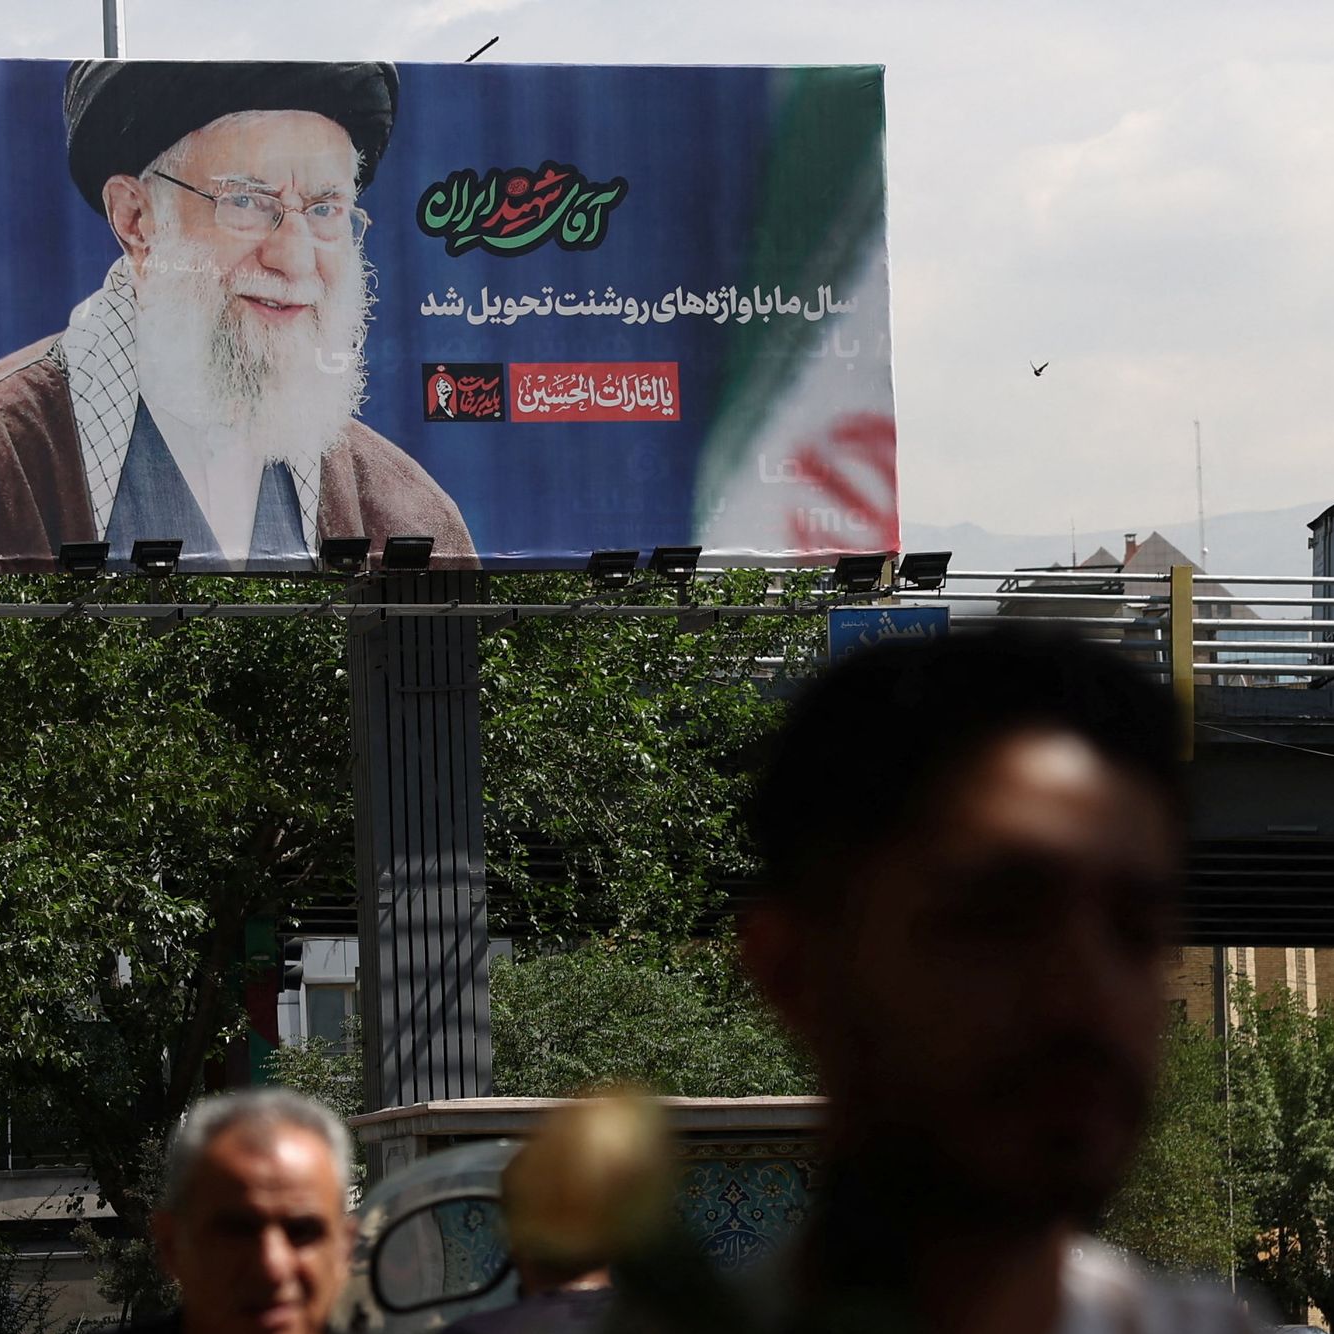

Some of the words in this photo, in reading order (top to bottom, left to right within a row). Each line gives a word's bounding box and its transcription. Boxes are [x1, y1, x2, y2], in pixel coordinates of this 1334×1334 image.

[425, 177, 497, 248] ایران
[420, 285, 465, 317] شد
[467, 285, 554, 326] تحویل
[554, 285, 650, 325] روشنت
[753, 284, 773, 323] با
[774, 284, 802, 315] ما
[803, 284, 859, 321] سال
